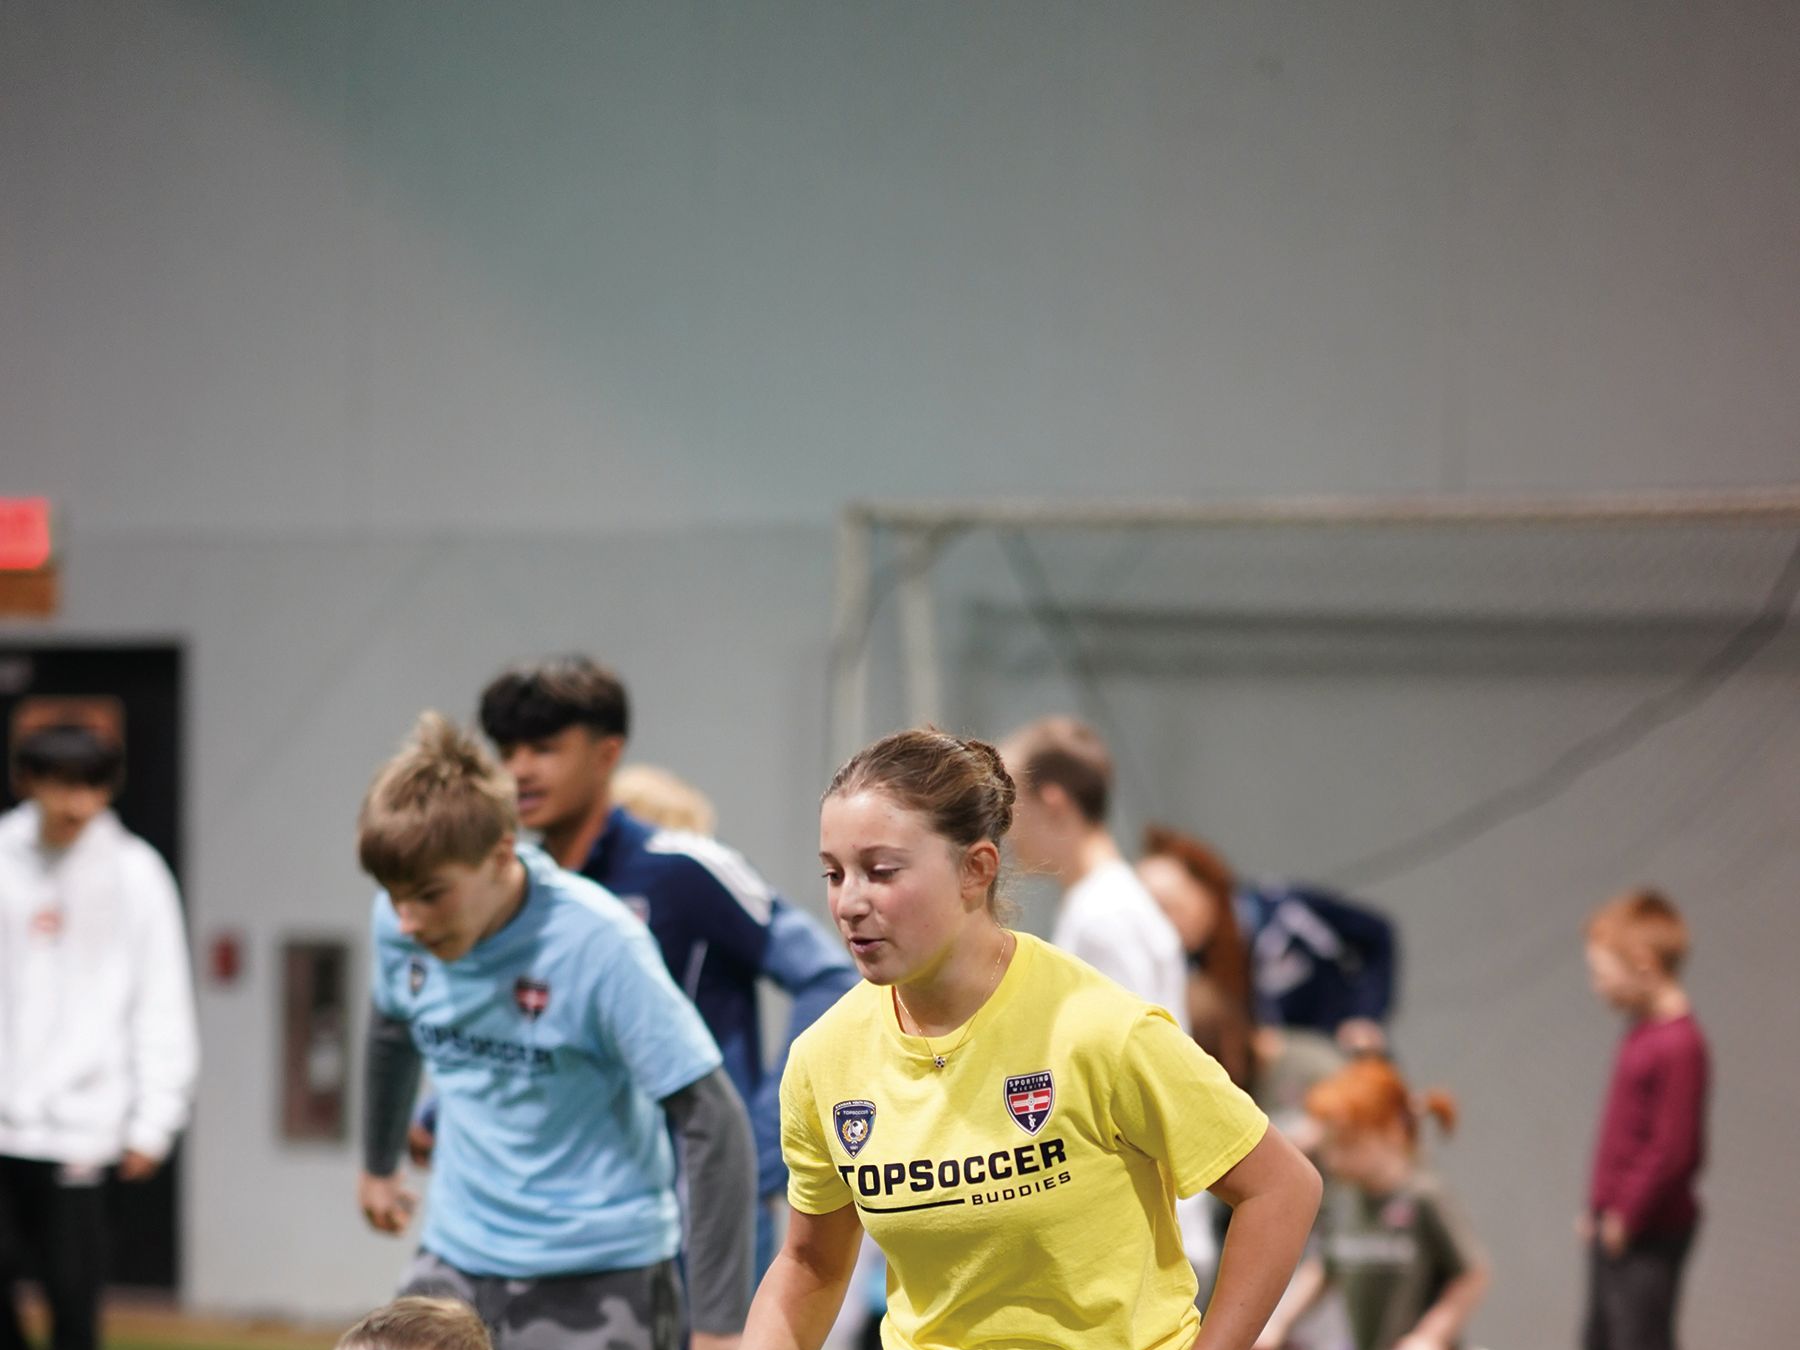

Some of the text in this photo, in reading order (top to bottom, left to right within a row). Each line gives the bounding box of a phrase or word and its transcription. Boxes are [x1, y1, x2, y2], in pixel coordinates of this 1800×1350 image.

[1009, 1074, 1049, 1088] SPORTING
[838, 1138, 1067, 1197] TOPSOCCER
[971, 1171, 1071, 1206] BUDDIES
